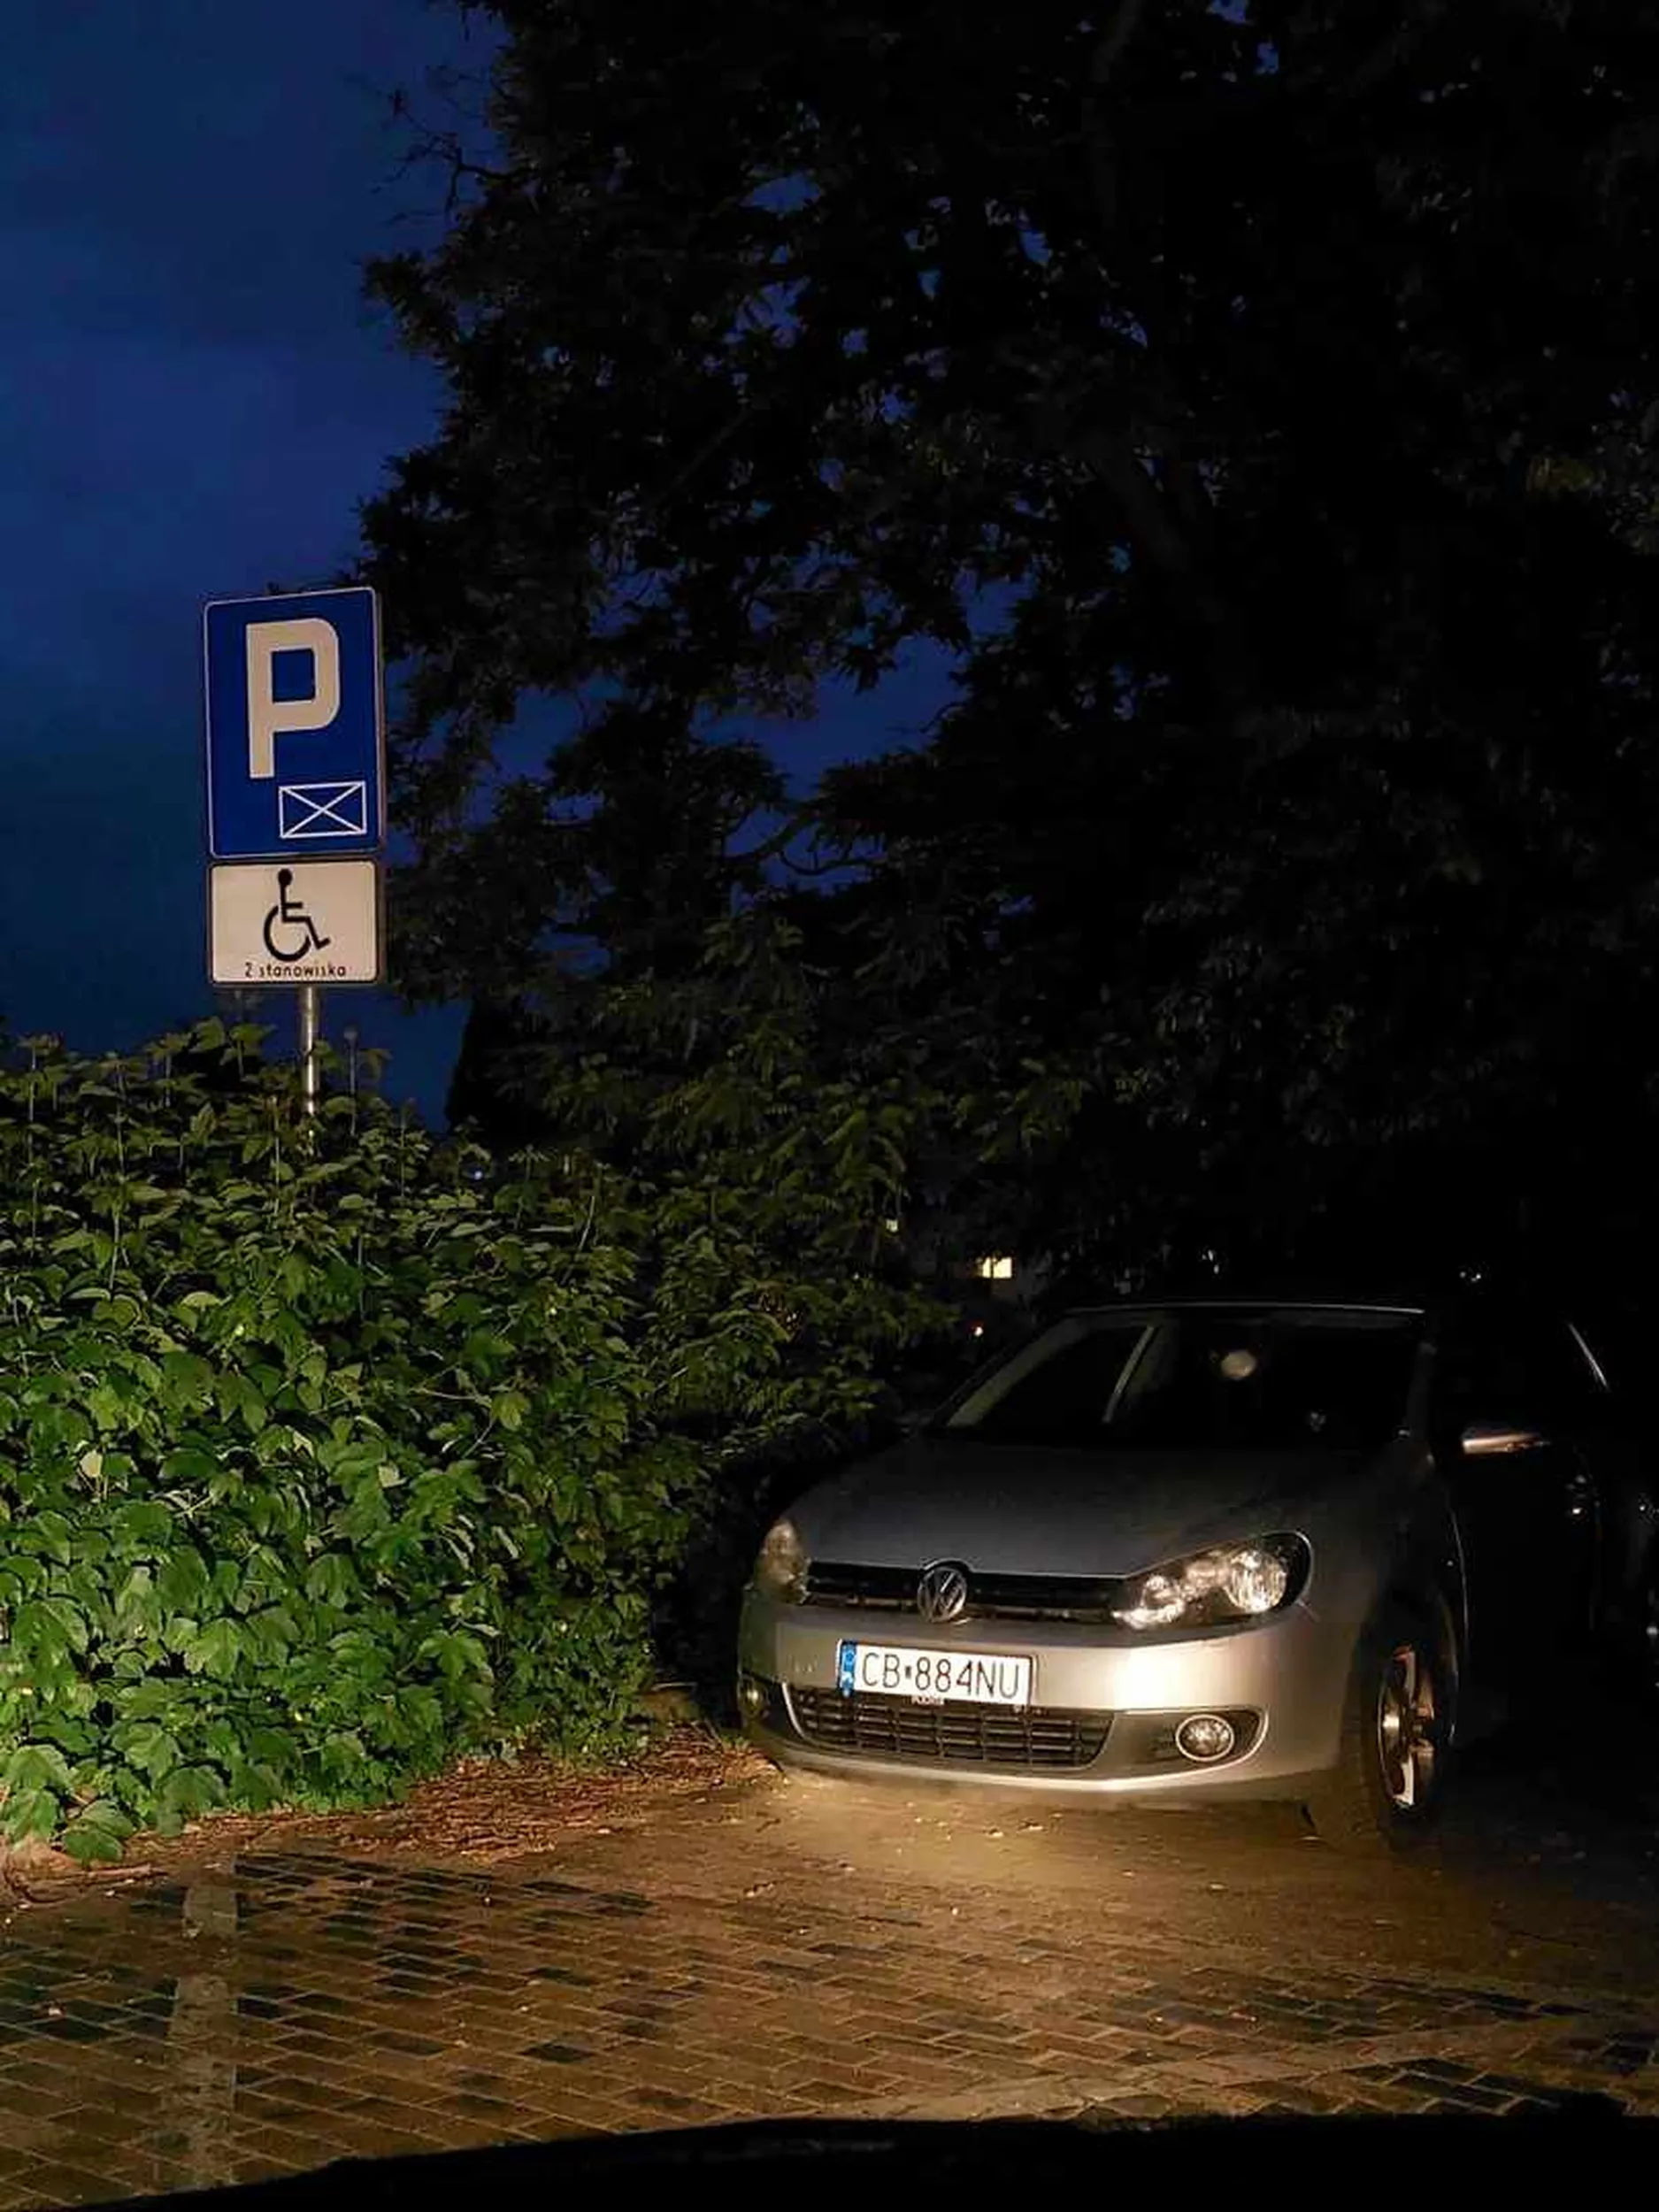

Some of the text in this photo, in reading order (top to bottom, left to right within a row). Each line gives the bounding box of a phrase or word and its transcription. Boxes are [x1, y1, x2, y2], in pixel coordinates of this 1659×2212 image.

[246, 618, 341, 779] P
[244, 962, 347, 978] 2 stanowiska
